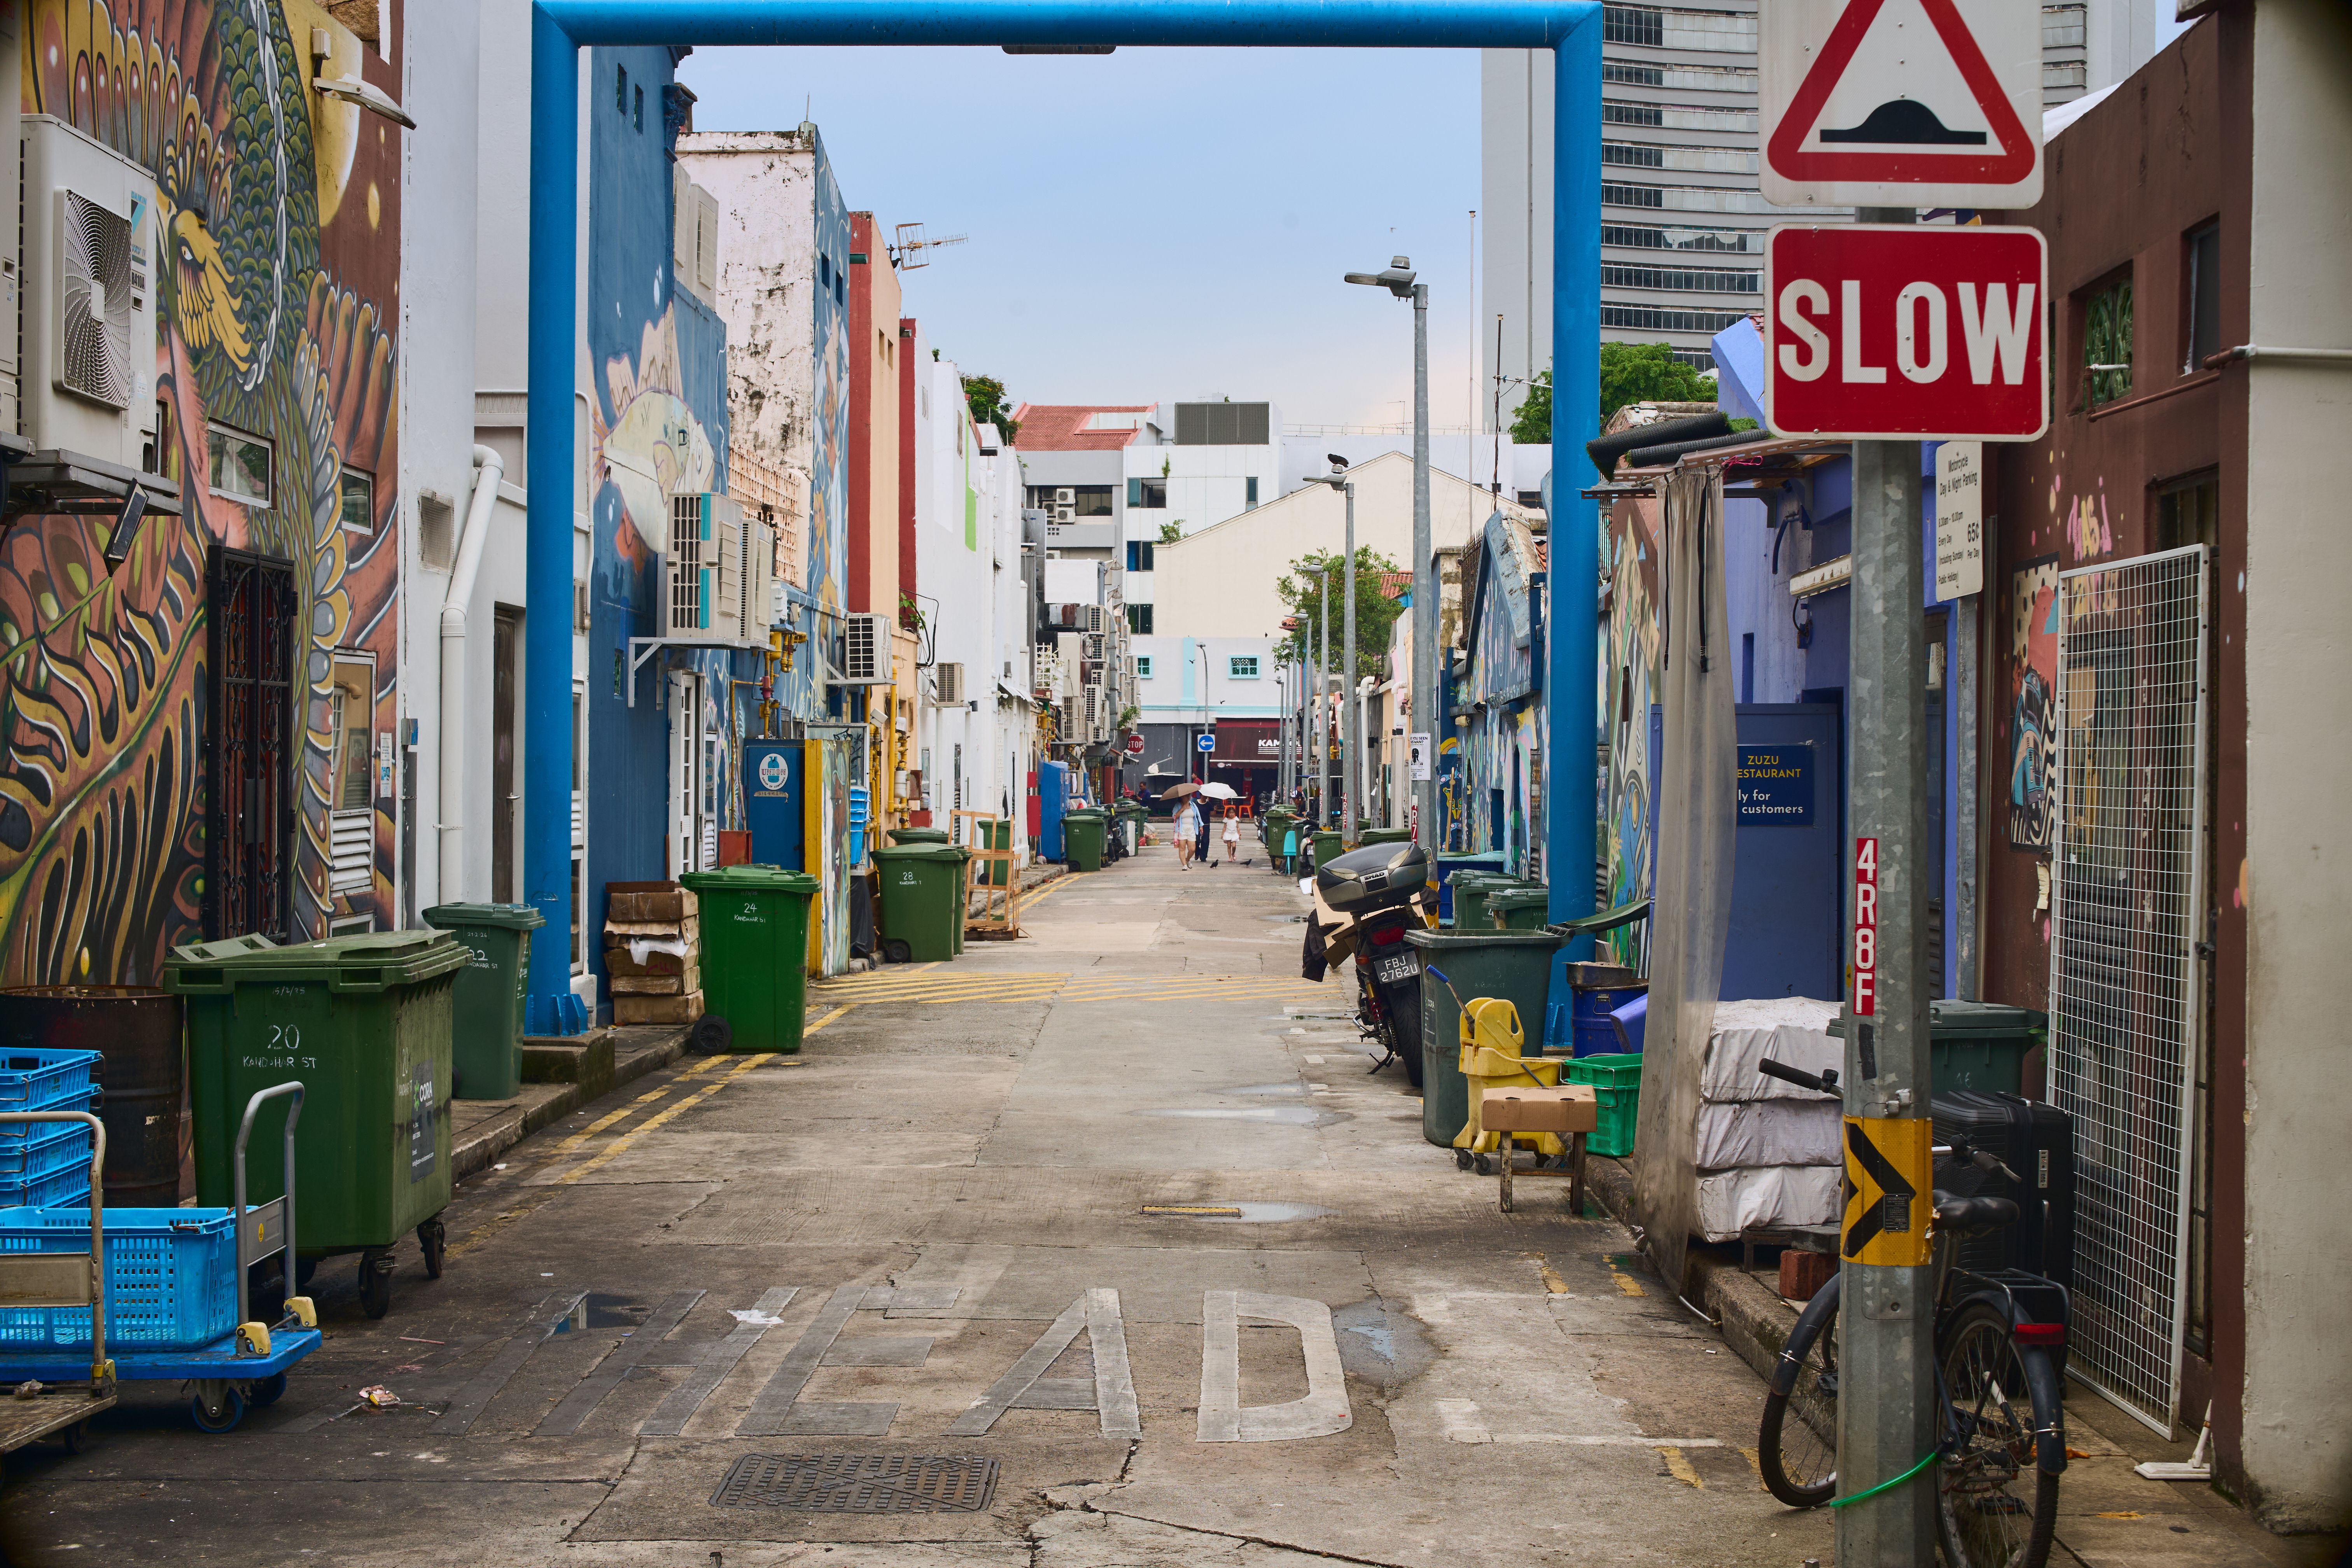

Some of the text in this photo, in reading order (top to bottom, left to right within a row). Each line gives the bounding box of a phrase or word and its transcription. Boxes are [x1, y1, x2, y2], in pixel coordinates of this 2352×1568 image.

[131, 190, 147, 205] DAIKIN
[131, 273, 145, 290] R410A
[1779, 278, 2036, 385] SLOW
[1948, 454, 1968, 473] Motorcycle
[1952, 476, 1962, 493] Night
[1963, 471, 1977, 488] Parking
[1939, 575, 1947, 585] Public
[1748, 756, 1779, 765] ZUZU
[1737, 769, 1801, 778] ESTAURANT
[1753, 789, 1770, 800] for
[1742, 804, 1803, 814] customers
[903, 872, 913, 880] 28
[1364, 872, 1384, 880] SHAD
[744, 903, 757, 913] 24
[1856, 840, 1876, 1013] 4R8F
[469, 950, 488, 961] 22
[1384, 956, 1406, 970] FBJ
[1381, 963, 1418, 982] 2762U
[267, 1024, 299, 1050] 20
[301, 1057, 317, 1069] ST
[402, 1047, 409, 1077] 20
[420, 1081, 432, 1102] CORA
